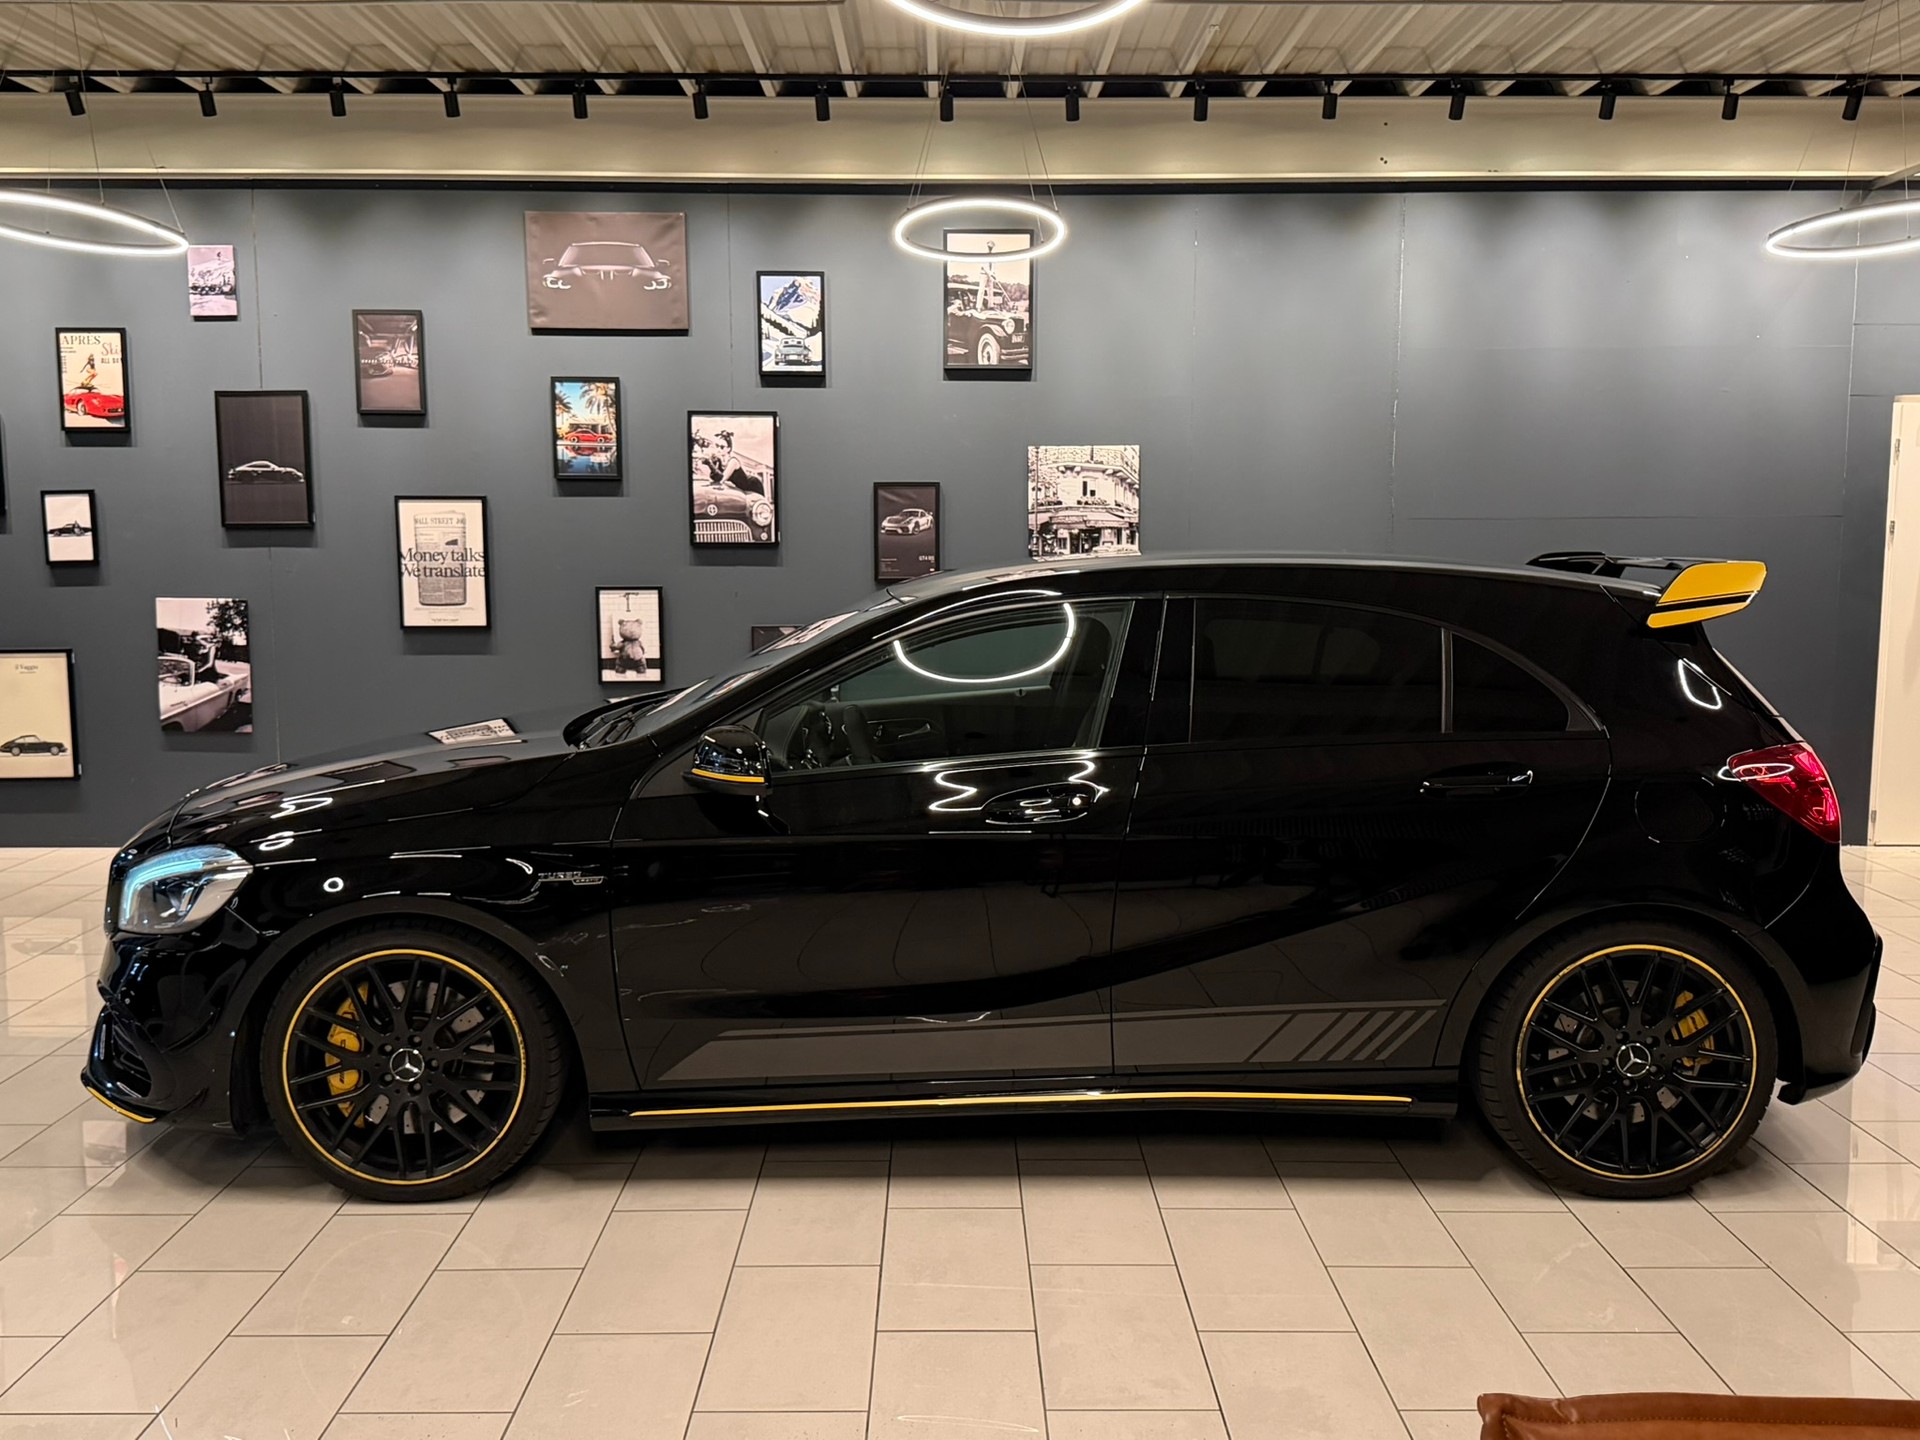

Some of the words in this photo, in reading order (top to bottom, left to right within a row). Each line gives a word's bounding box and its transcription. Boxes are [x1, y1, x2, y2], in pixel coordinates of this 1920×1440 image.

[101, 342, 119, 356] Ski
[430, 517, 453, 525] STREET
[401, 547, 449, 565] Money
[451, 547, 484, 562] talks
[402, 563, 421, 578] We
[423, 563, 485, 578] translate
